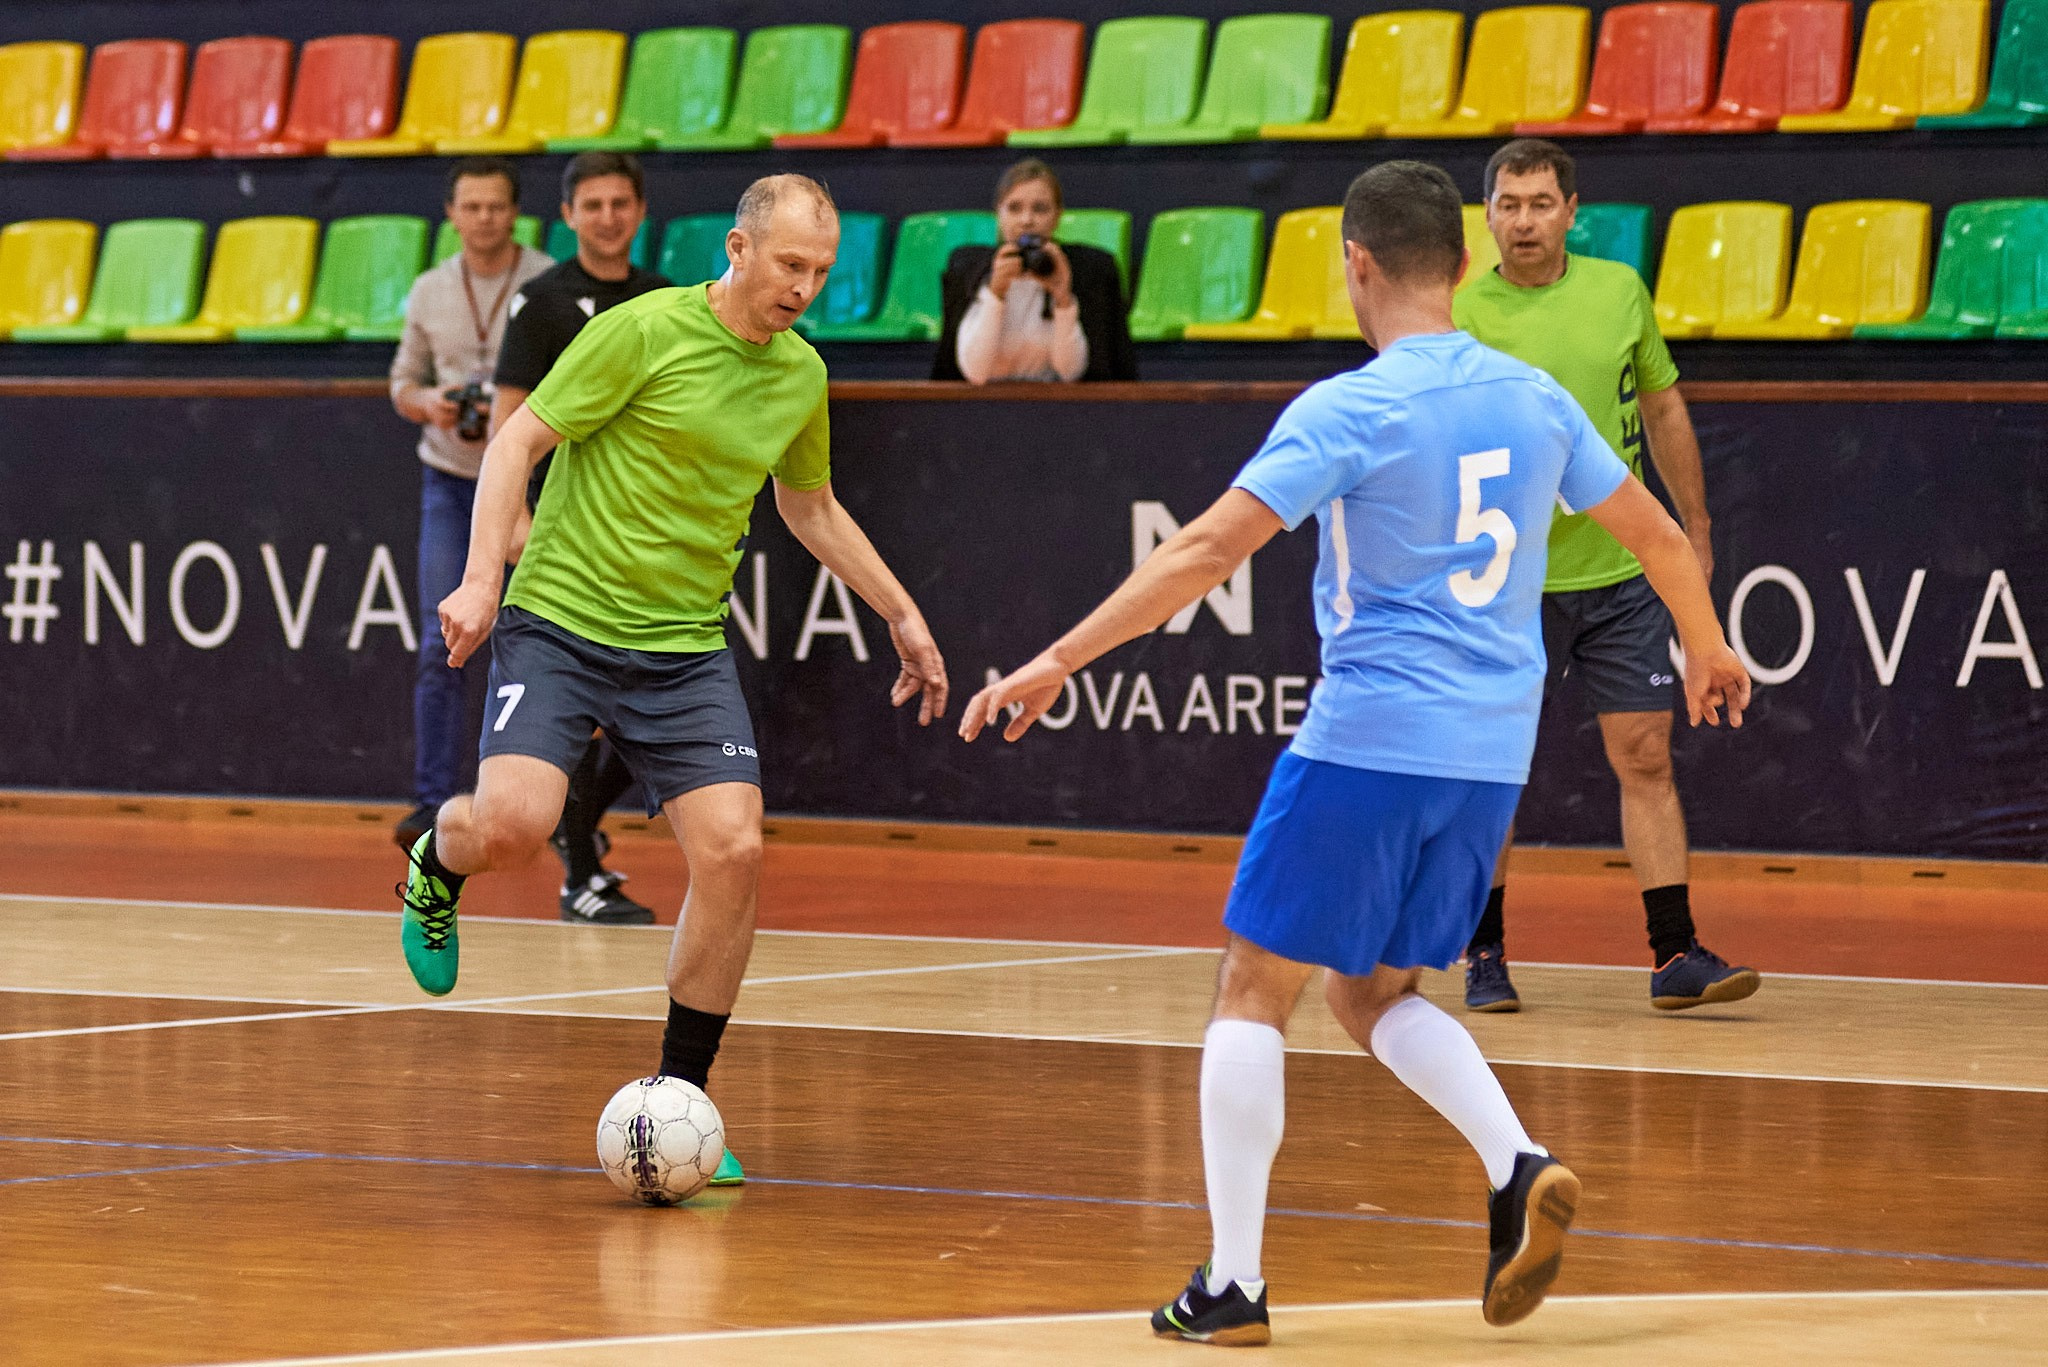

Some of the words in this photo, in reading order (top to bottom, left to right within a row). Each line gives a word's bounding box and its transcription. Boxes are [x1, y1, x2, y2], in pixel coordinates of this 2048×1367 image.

[1448, 447, 1518, 608] 5
[1669, 564, 2044, 689] OVA
[493, 683, 526, 732] 7
[1177, 673, 1324, 735] ARE
